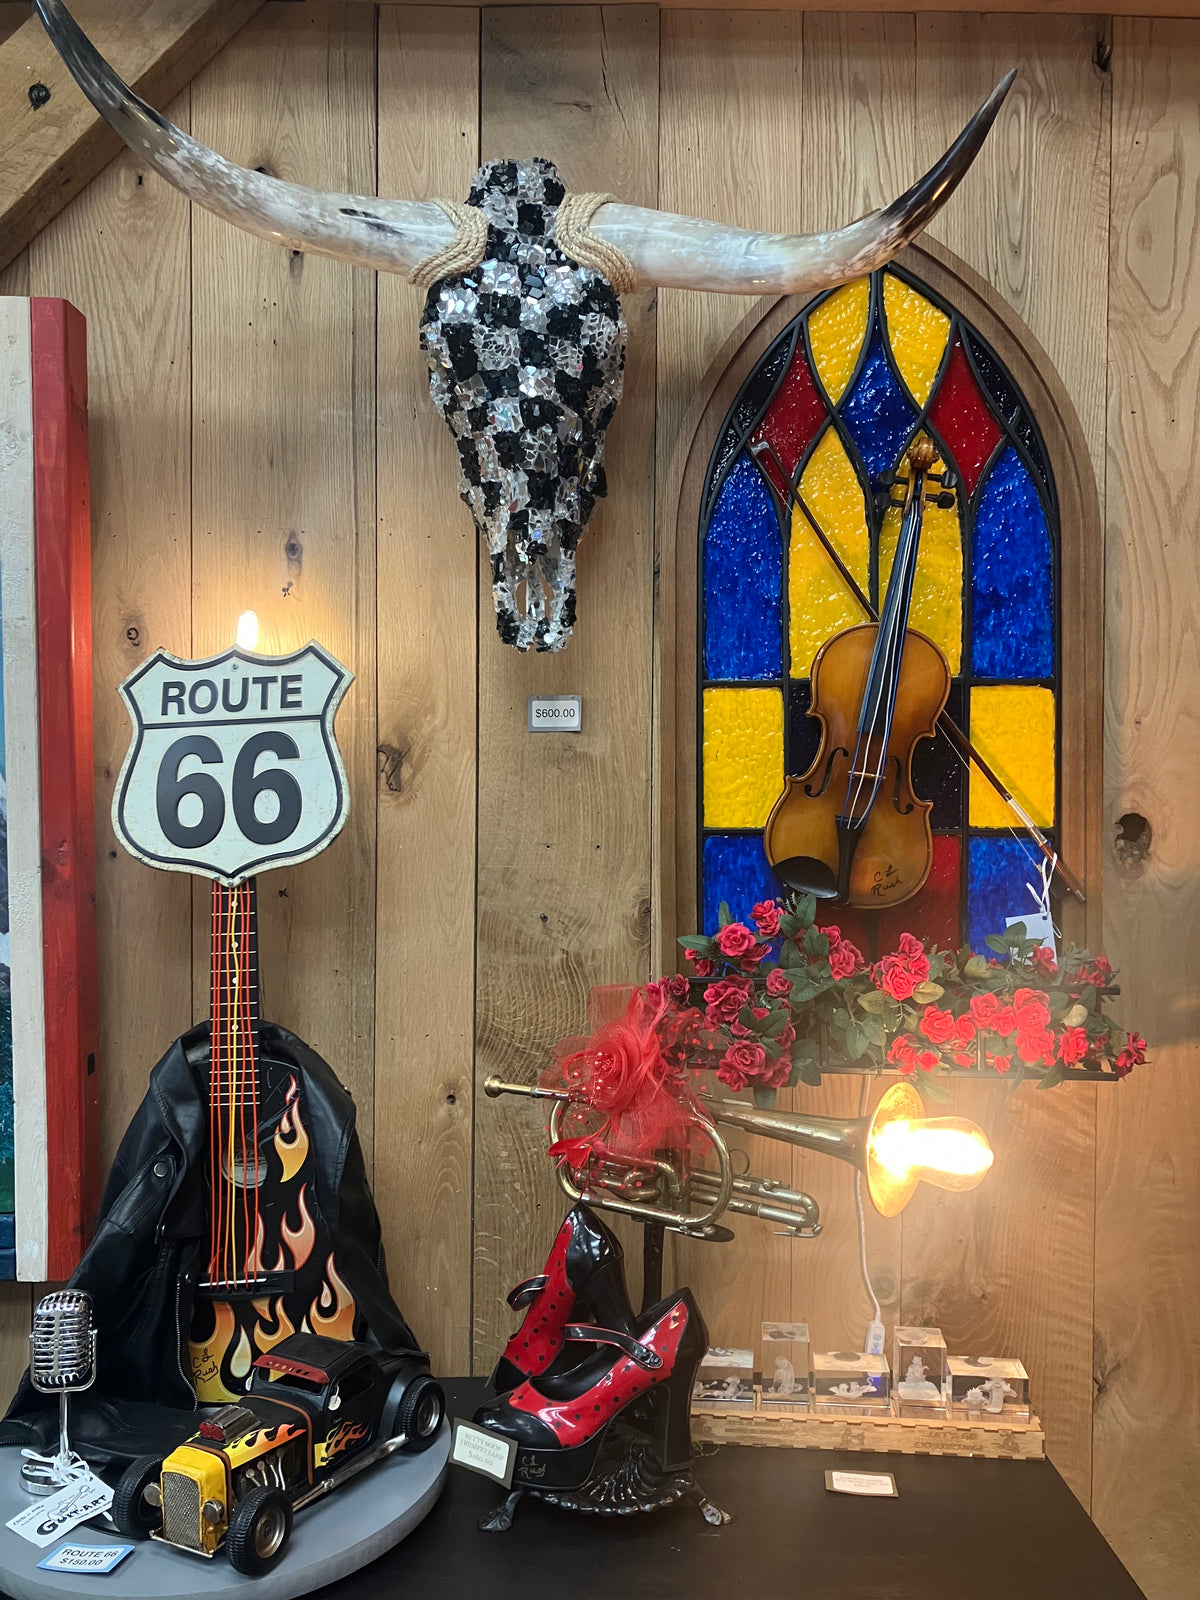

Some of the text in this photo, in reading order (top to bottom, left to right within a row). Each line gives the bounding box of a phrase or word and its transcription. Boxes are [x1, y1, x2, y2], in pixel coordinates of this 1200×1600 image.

[160, 674, 303, 716] ROUTE
[535, 708, 576, 719] $600.00
[156, 731, 303, 849] 66
[61, 1548, 119, 1558] ROUTE 66
[59, 1557, 104, 1566] $150.00
